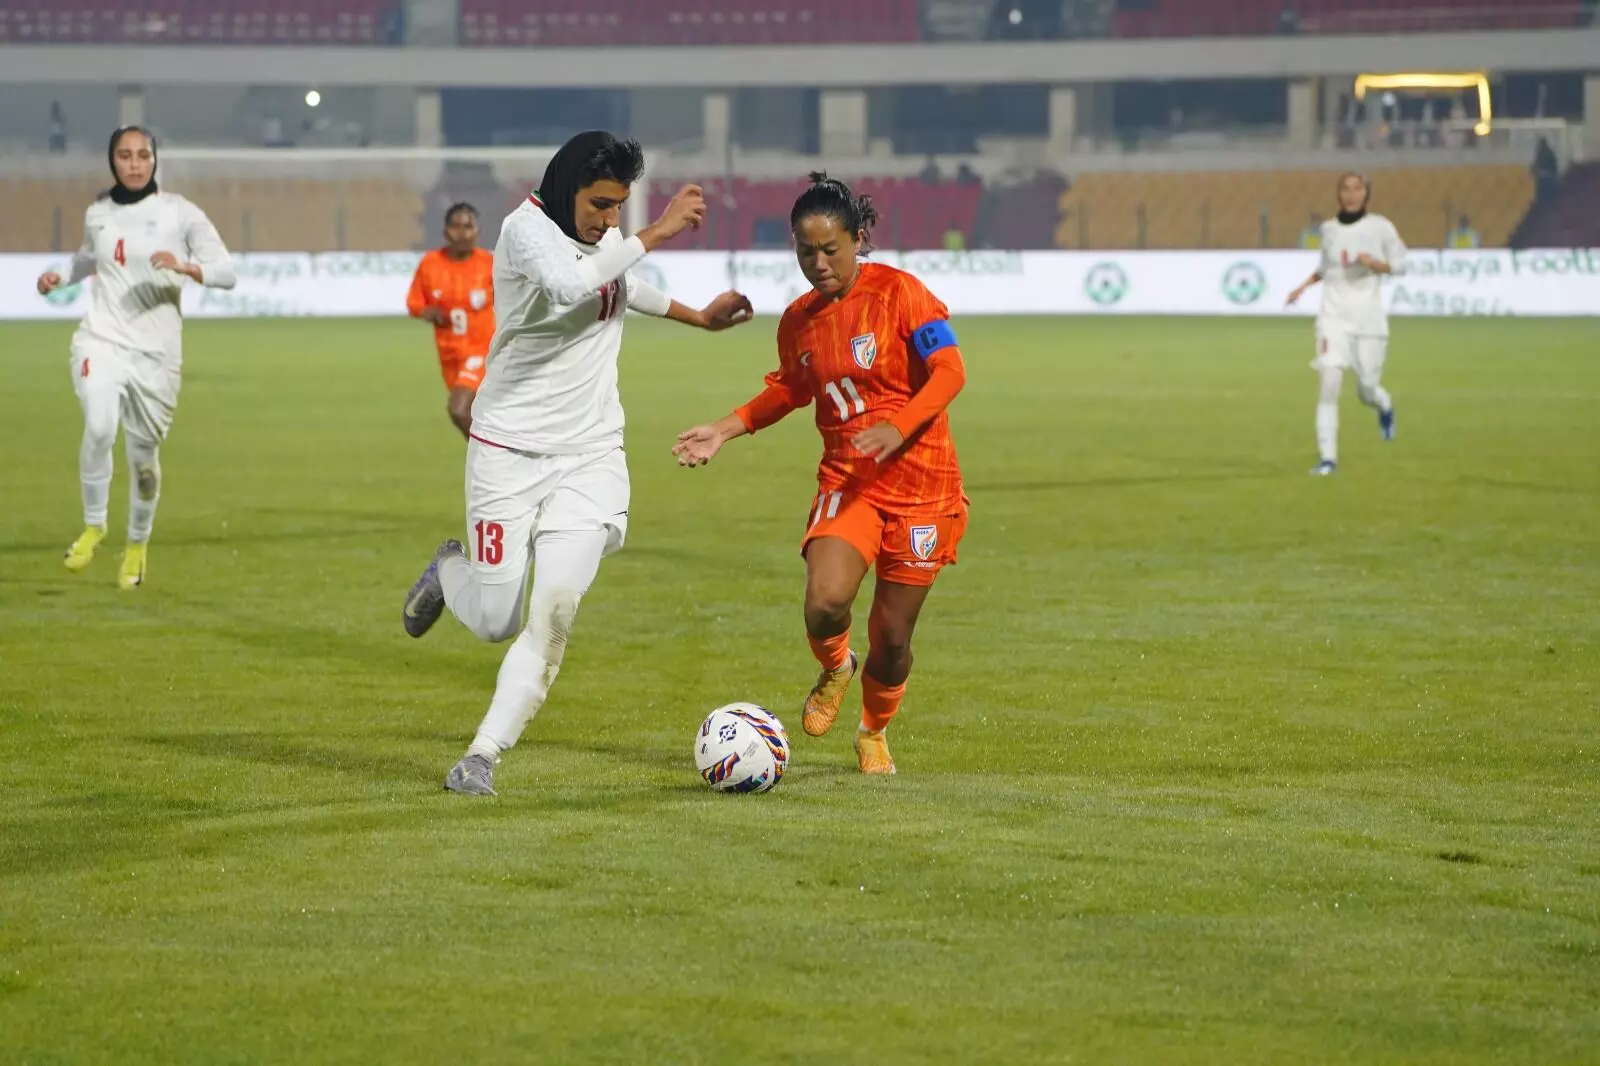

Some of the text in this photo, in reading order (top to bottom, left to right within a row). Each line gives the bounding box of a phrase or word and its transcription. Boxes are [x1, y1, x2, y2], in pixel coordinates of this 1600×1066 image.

[114, 238, 126, 267] 4
[449, 308, 468, 335] 9
[919, 327, 939, 350] C
[81, 357, 90, 378] 4
[825, 376, 865, 422] 11
[813, 490, 843, 527] 11
[474, 519, 505, 566] 13
